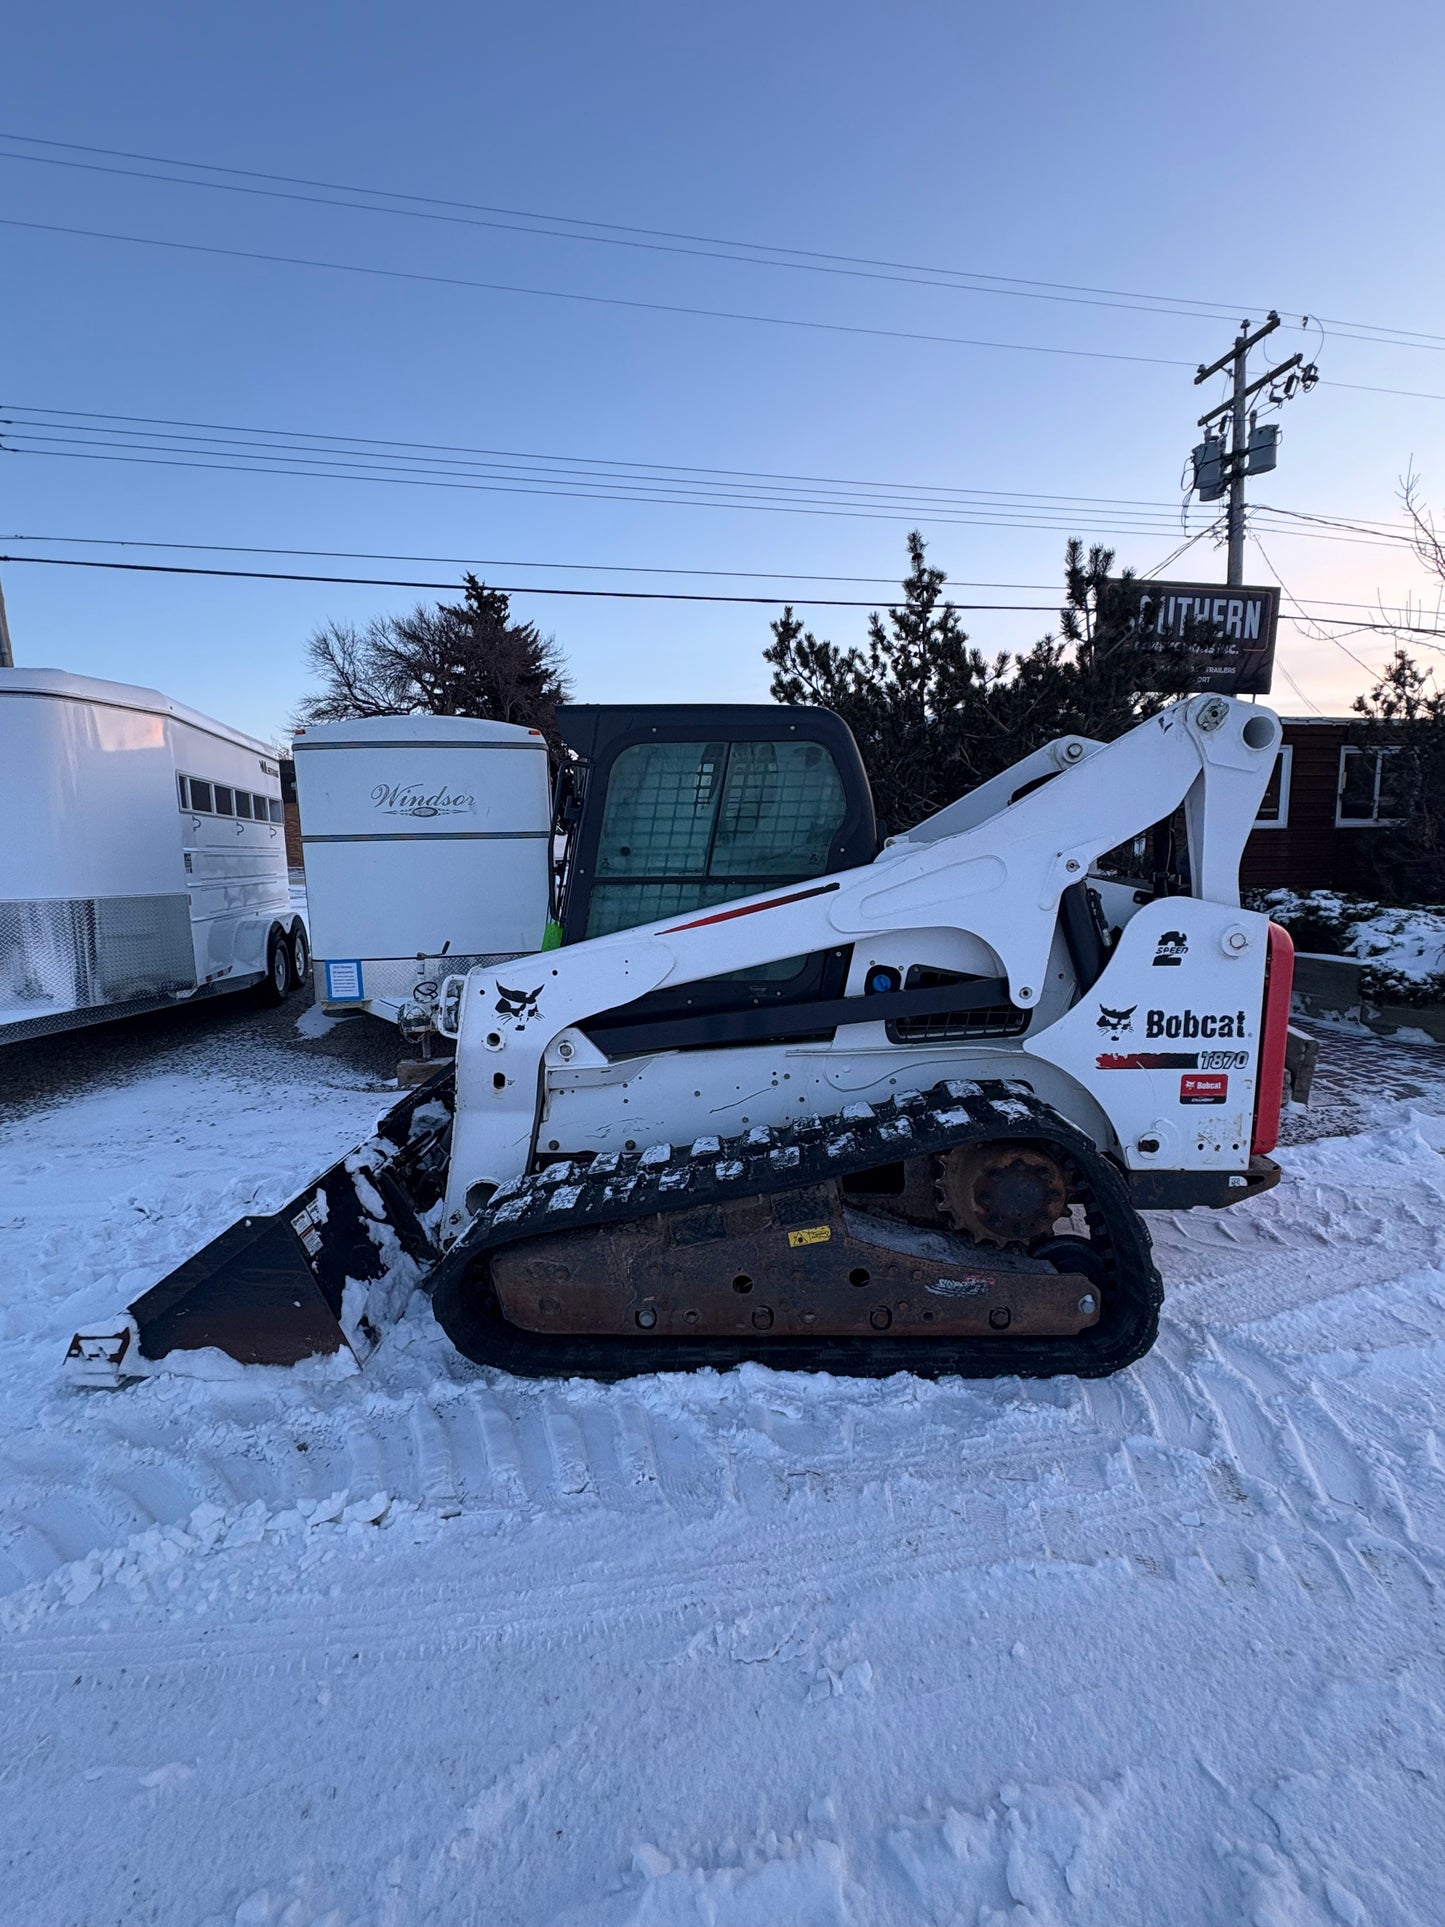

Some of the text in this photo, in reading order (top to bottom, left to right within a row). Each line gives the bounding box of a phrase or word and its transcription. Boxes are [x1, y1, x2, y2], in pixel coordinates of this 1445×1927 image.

[370, 783, 476, 808] Windsor
[1146, 1009, 1246, 1038] Bobcat
[1201, 1051, 1249, 1070] T870
[1197, 1081, 1222, 1090] Bobcat
